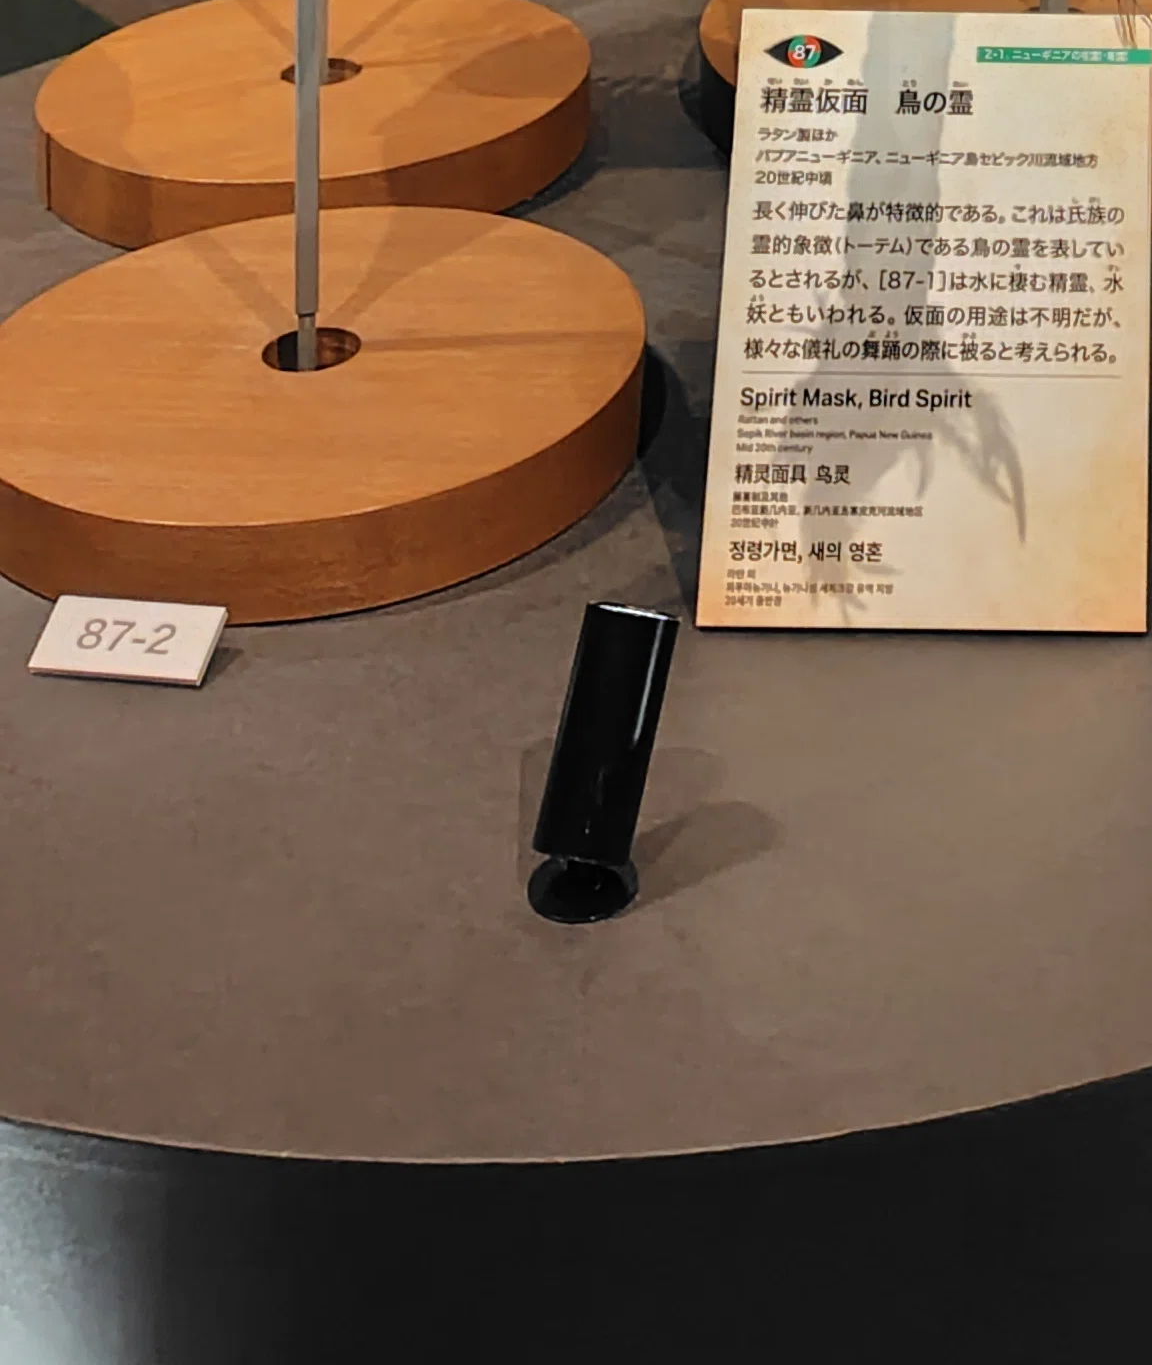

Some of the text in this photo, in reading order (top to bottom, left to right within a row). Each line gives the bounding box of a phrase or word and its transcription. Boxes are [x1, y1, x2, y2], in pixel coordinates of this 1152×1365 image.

[792, 44, 816, 61] 87
[760, 87, 974, 116] 精霊仮面 鳥の霊
[754, 170, 833, 186] 20世紀中頃
[745, 302, 1122, 329] 妖ともいわれる。仮面の用途は不明だが、
[740, 386, 973, 412] Spirit Mask, Bird Spirit
[879, 429, 898, 439] New
[735, 462, 851, 485] 精灵面具 鸟灵
[729, 539, 883, 564] 정령가면, 새의 영혼
[76, 617, 178, 656] 87-2
